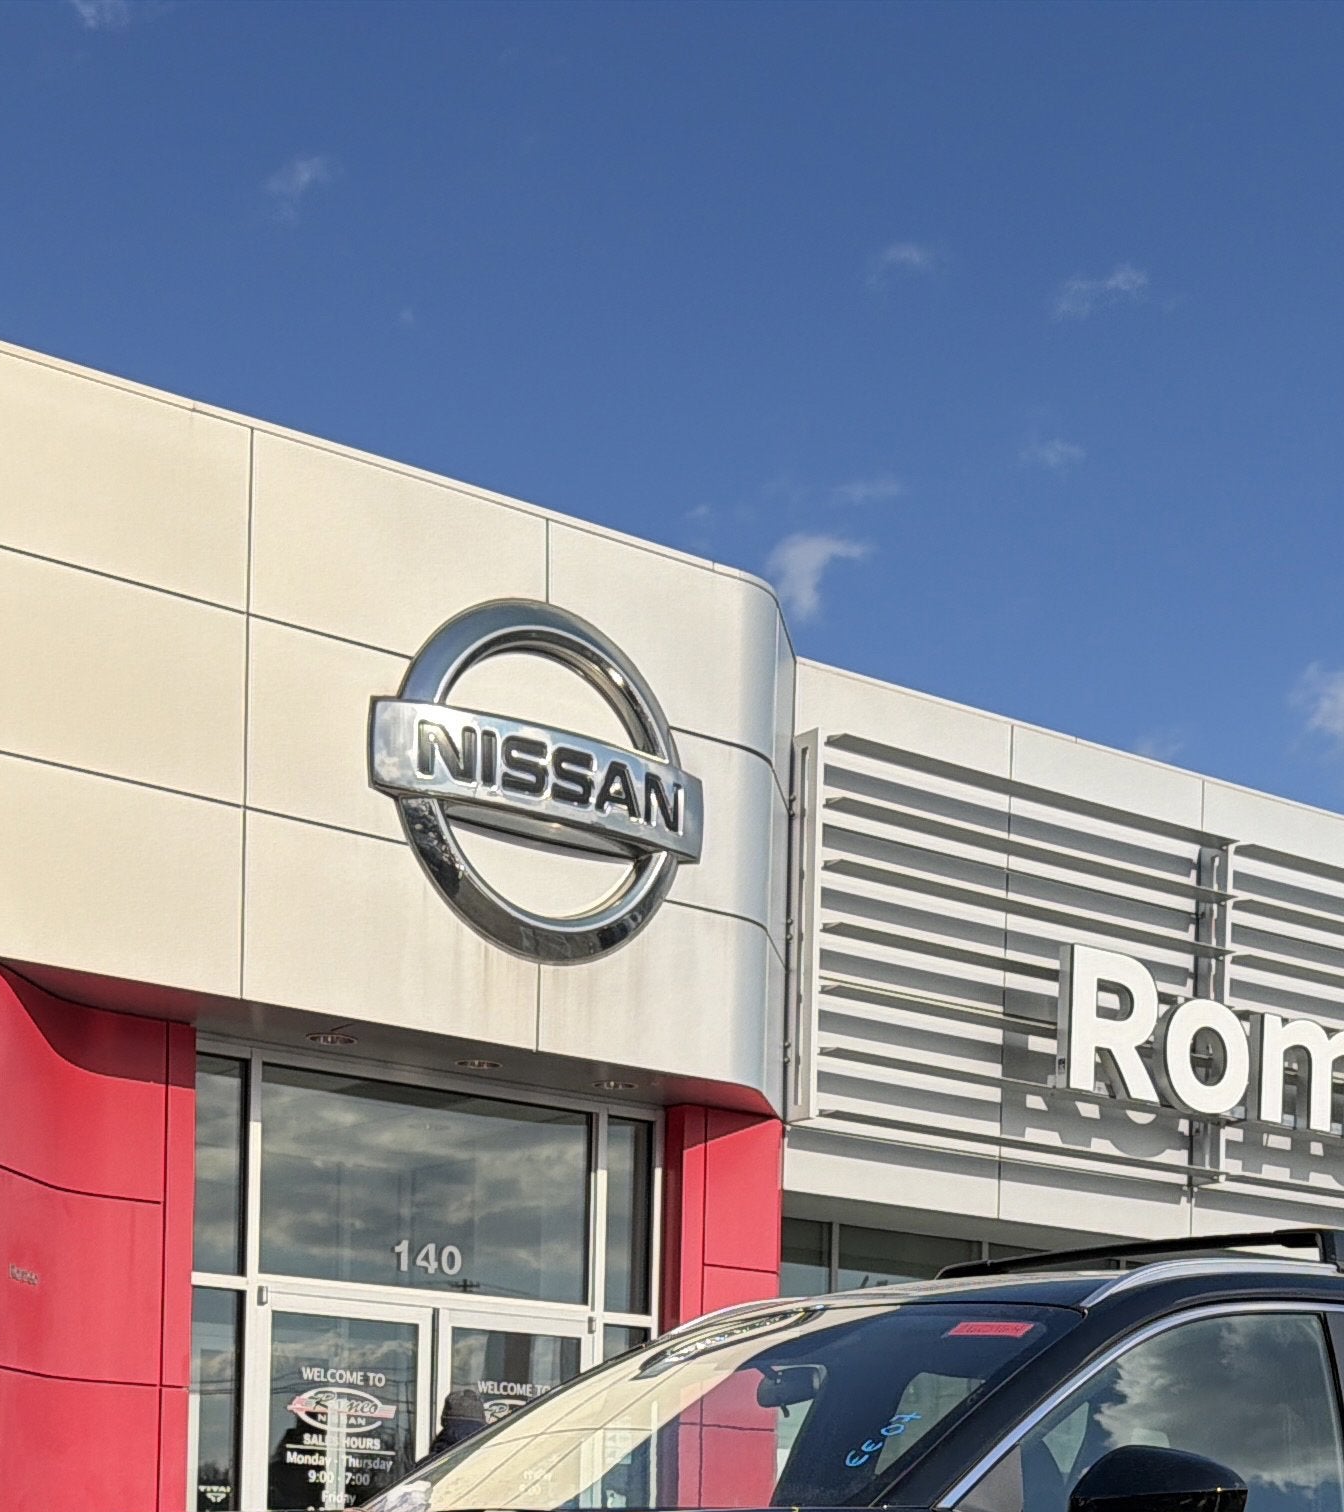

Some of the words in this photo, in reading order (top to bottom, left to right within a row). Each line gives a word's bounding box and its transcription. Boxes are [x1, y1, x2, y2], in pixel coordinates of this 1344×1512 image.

[416, 718, 684, 836] NISSAN
[394, 1240, 462, 1276] 140
[301, 1367, 364, 1385] WELCOME
[367, 1373, 385, 1387] TO
[477, 1381, 533, 1397] WELCOME
[308, 1390, 379, 1414] Rmeo
[303, 1433, 339, 1448] SAL
[286, 1451, 331, 1467] Monday
[341, 1454, 393, 1472] Thursday
[307, 1469, 334, 1483] 9:00
[345, 1472, 370, 1486] 7:00
